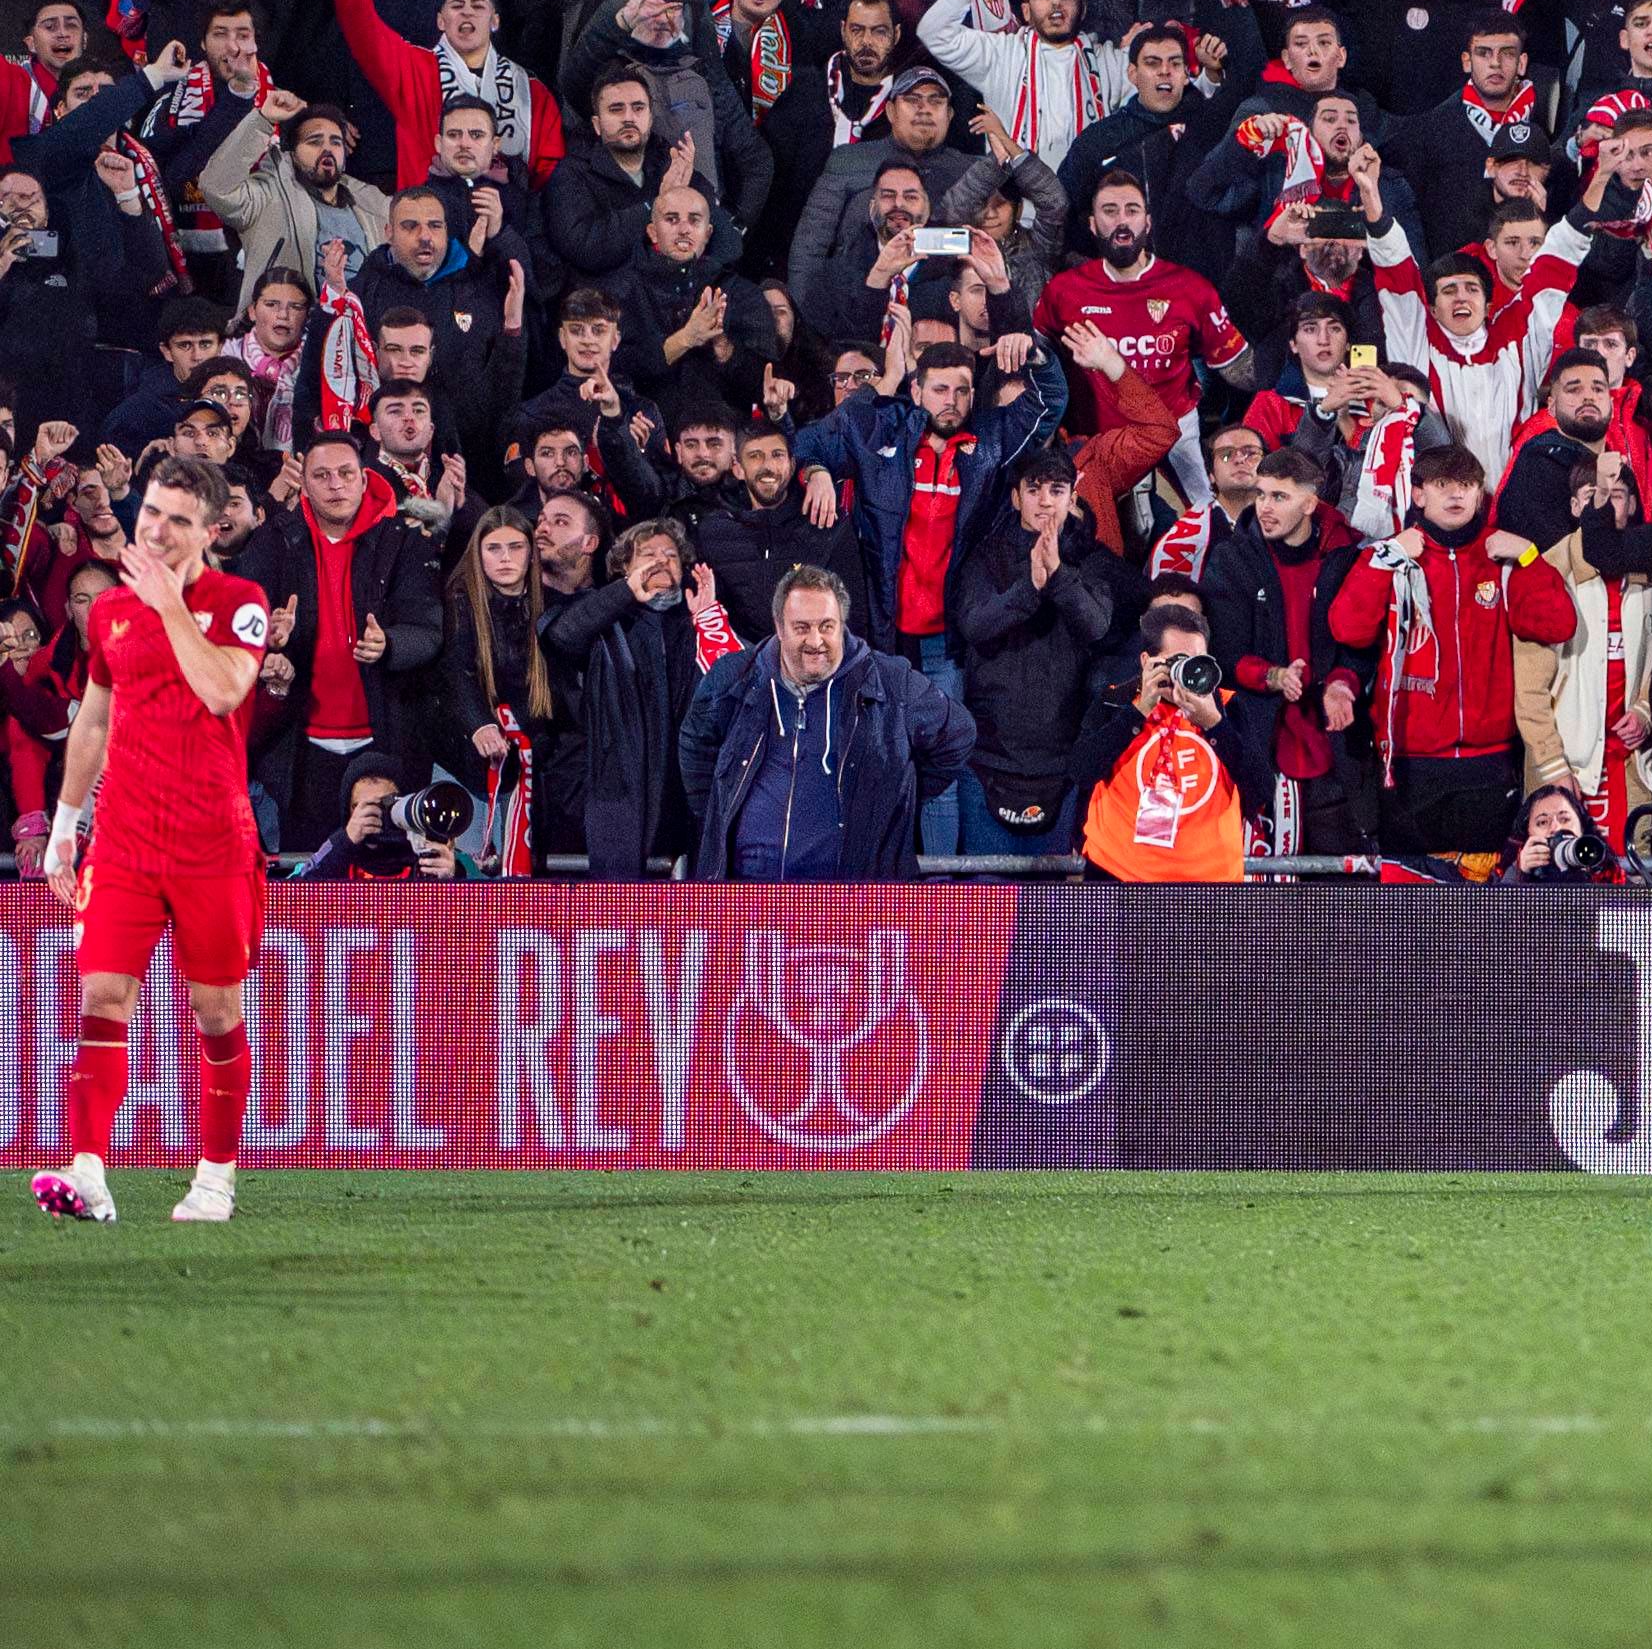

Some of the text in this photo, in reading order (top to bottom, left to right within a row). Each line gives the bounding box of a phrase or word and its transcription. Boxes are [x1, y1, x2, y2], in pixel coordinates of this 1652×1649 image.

[237, 614, 266, 638] JD
[243, 927, 445, 1152] DEL
[497, 927, 708, 1153] REY
